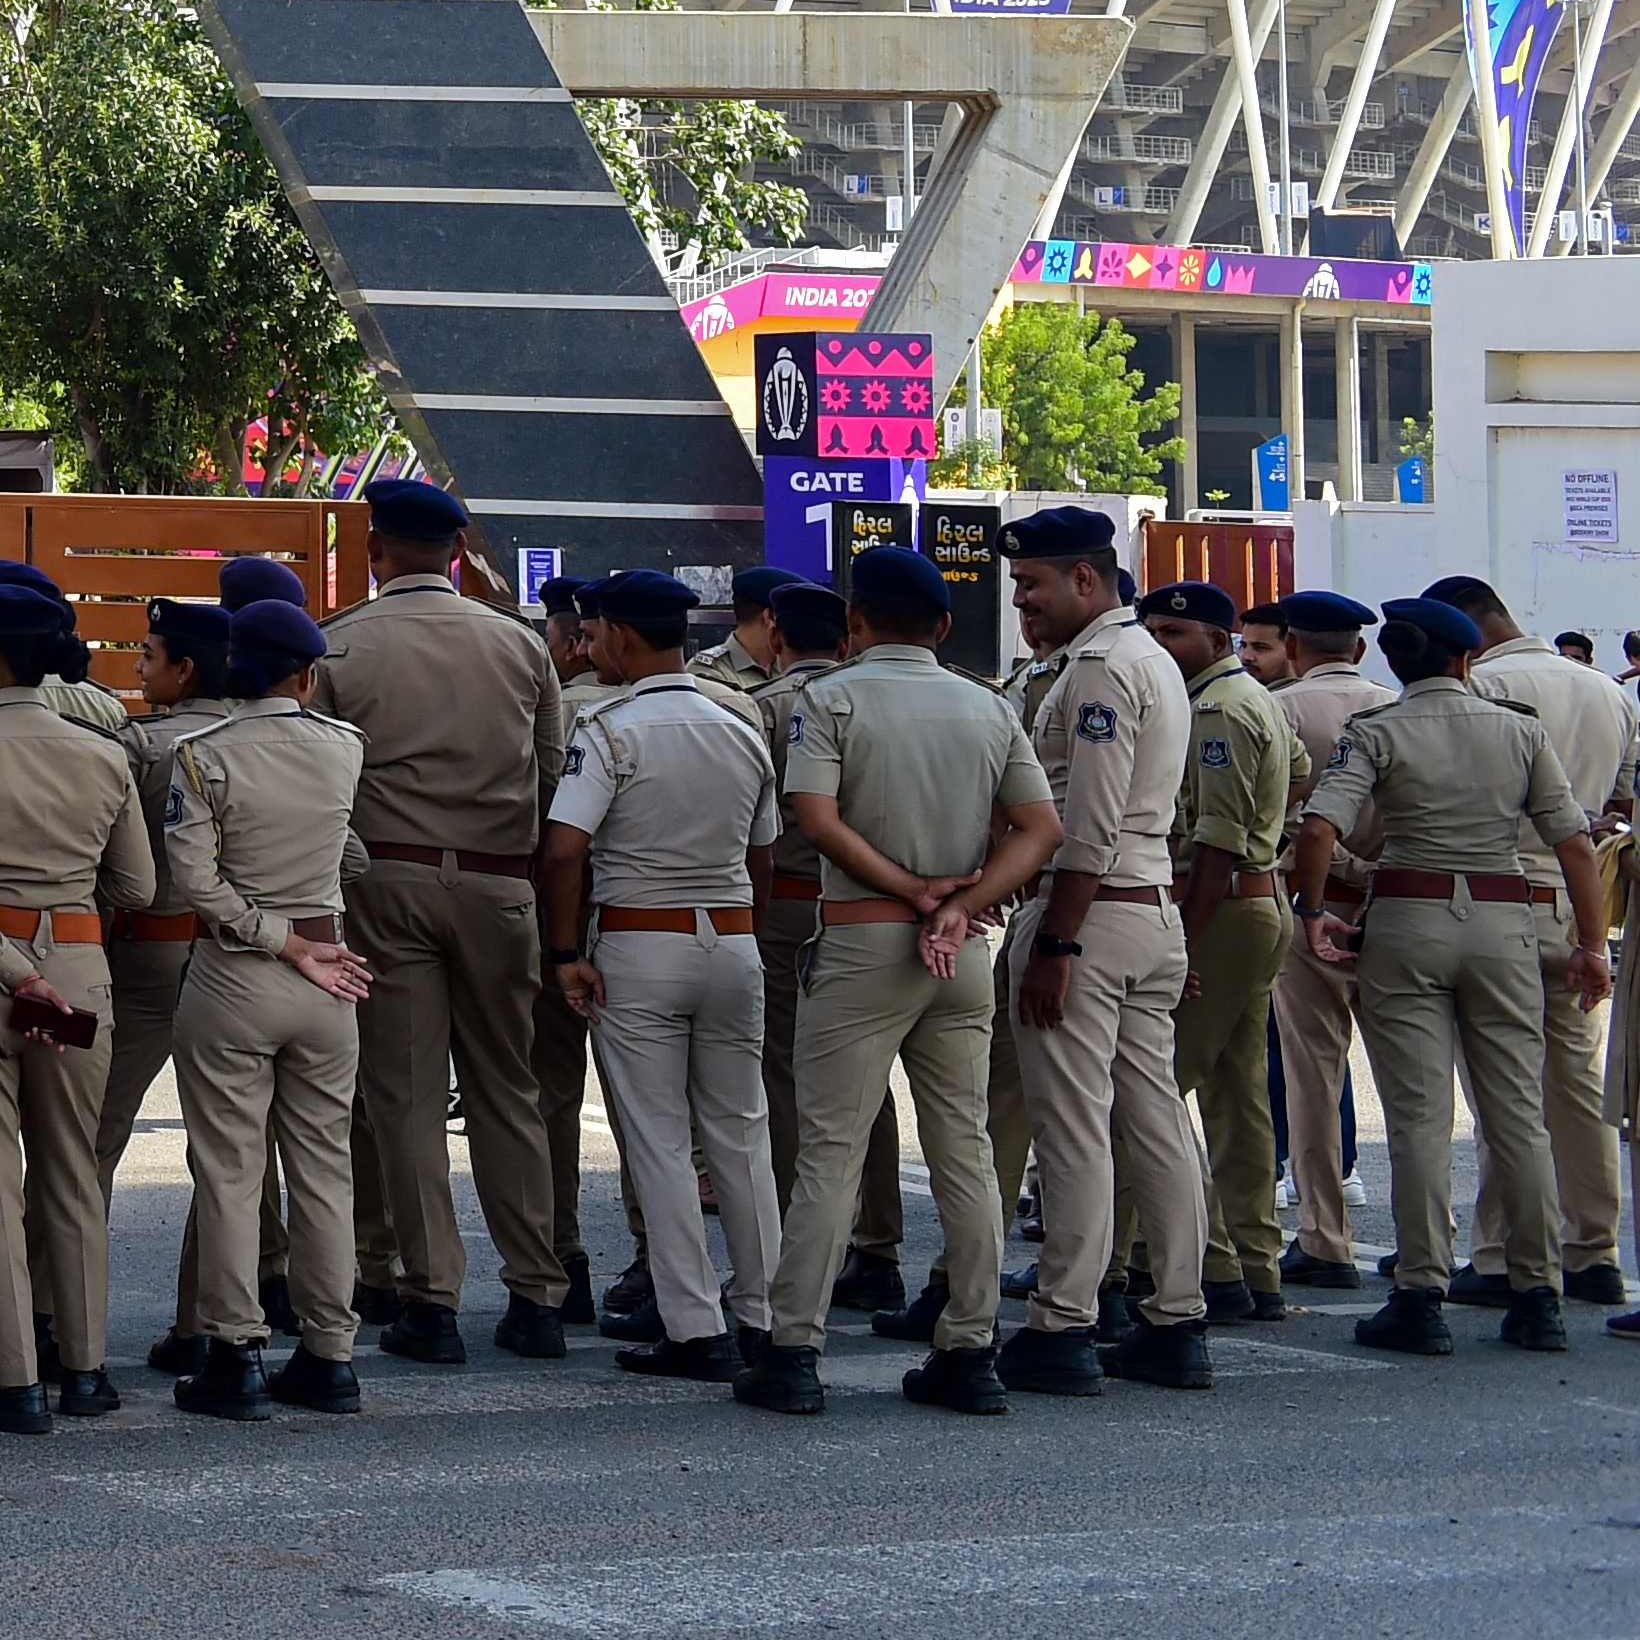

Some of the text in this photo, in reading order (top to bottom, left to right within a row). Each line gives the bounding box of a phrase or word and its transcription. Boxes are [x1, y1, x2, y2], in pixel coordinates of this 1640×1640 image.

[785, 287, 838, 307] INDIA
[789, 471, 864, 492] GATE
[1565, 474, 1609, 483] NO OFFLINE
[805, 502, 833, 571] 1
[936, 514, 984, 543] હિરલ
